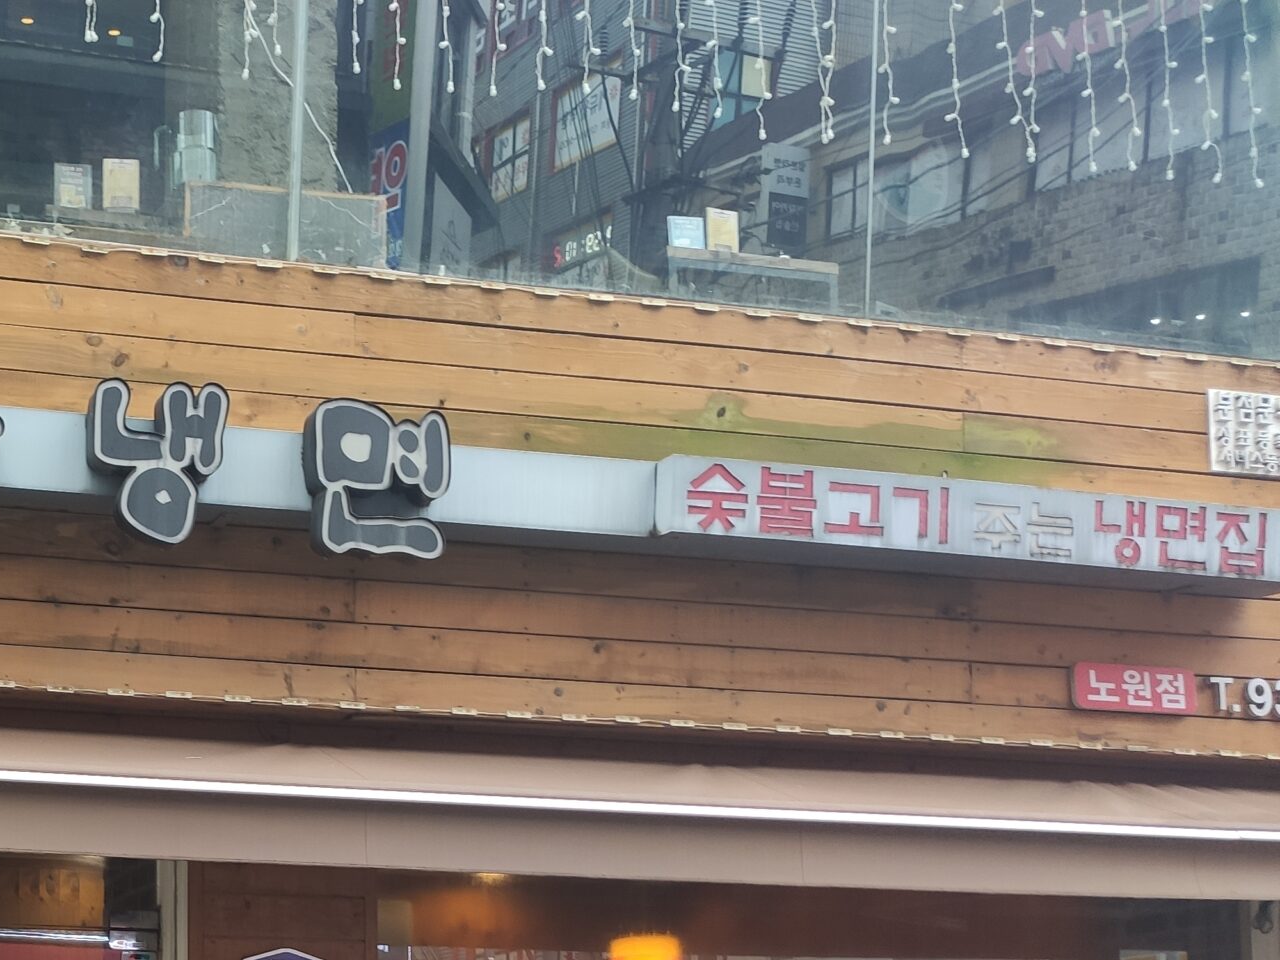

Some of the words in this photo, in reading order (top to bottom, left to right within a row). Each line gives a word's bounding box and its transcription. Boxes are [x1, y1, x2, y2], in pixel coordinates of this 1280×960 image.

[686, 463, 949, 545] 숯불고기
[974, 501, 1074, 559] 주는
[1094, 499, 1268, 576] 냉면집
[1086, 668, 1187, 710] 노원점
[1209, 677, 1280, 718] T.9
